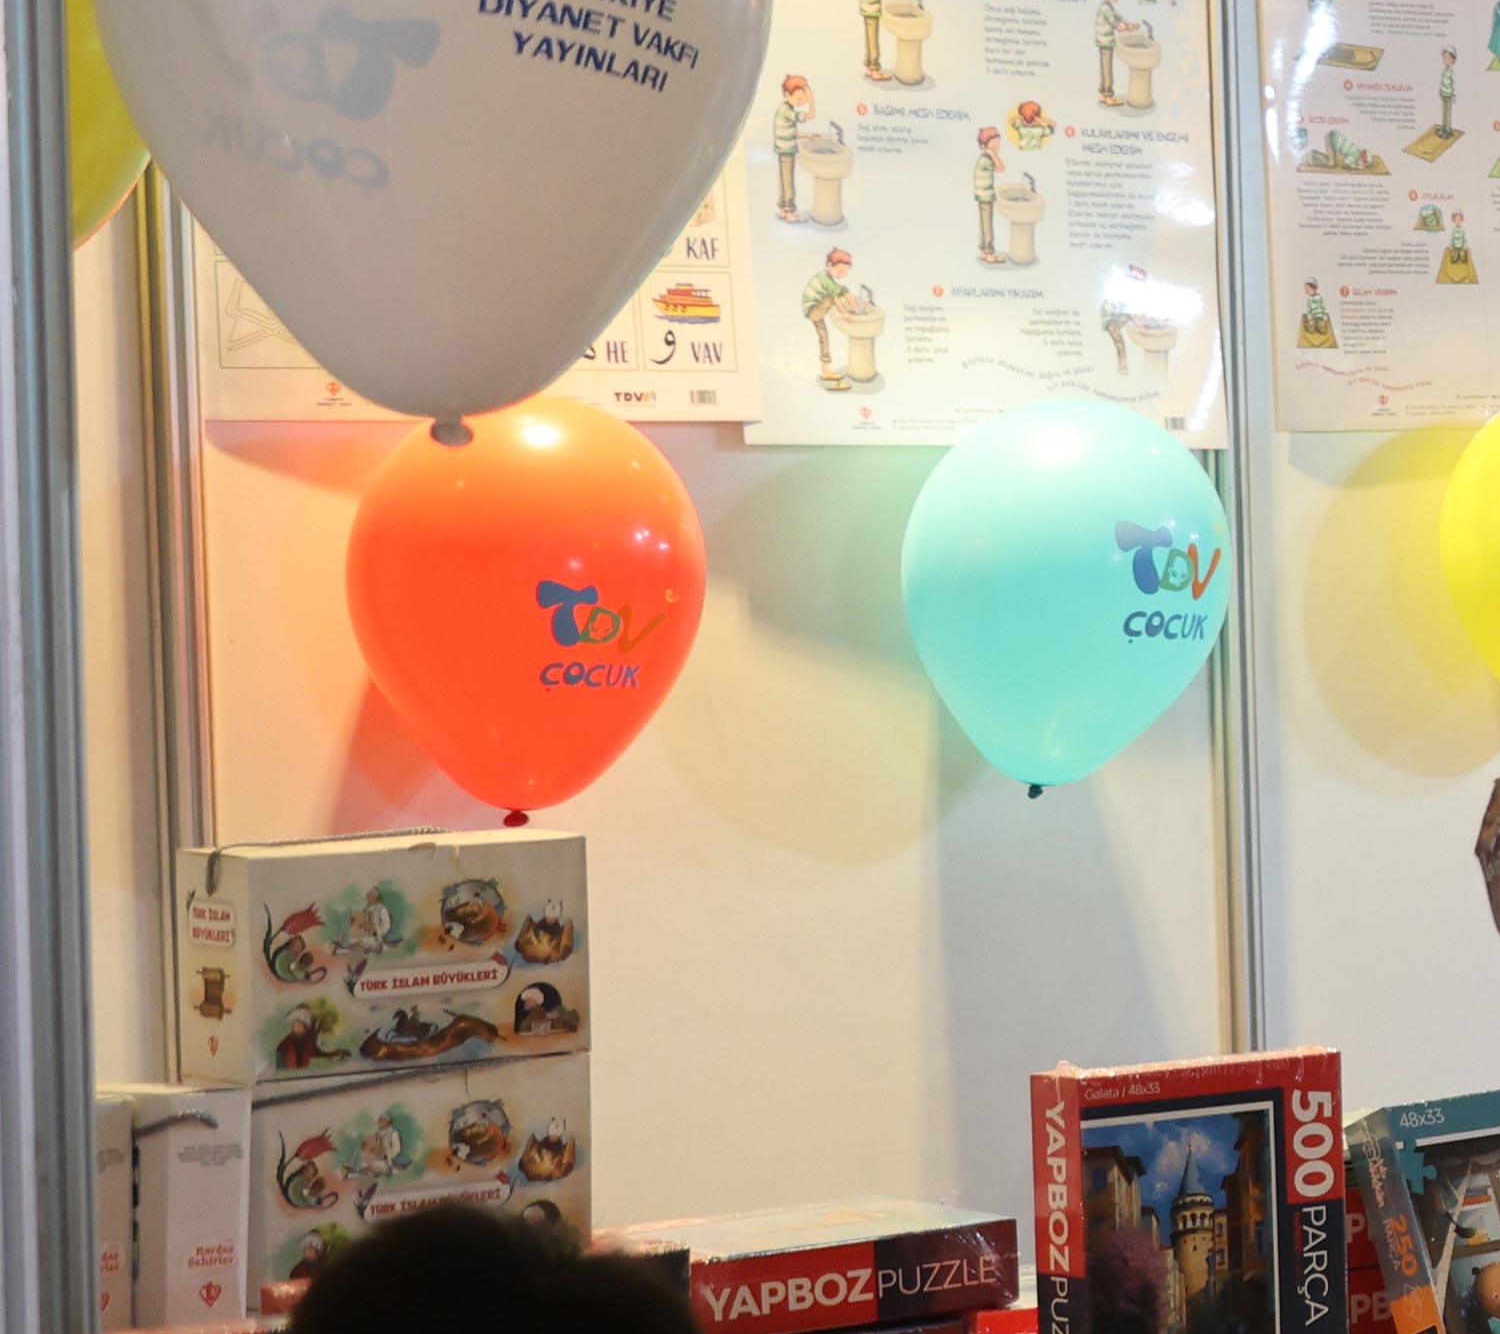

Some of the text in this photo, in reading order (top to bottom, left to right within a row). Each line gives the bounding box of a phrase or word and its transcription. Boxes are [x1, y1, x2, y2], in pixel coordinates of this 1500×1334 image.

[512, 31, 670, 93] YAYINLARI
[631, 20, 700, 70] VAKFI
[685, 236, 721, 261] KAF
[606, 340, 631, 364] HE
[690, 341, 724, 365] VAV
[1115, 519, 1222, 600] TDV
[535, 579, 667, 655] TDV
[1122, 610, 1209, 645] ÇOCUK
[539, 661, 642, 693] ÇOCUK
[359, 966, 499, 993] TÜRK İSLAM BÜYÜKLERİ
[1084, 1083, 1118, 1101] Galata
[1128, 1081, 1162, 1096] 48x33
[1399, 1107, 1446, 1129] 48x33
[1043, 1099, 1072, 1275] YAPBOZ
[1290, 1087, 1335, 1328] 500 PARÇA
[1389, 1213, 1419, 1278] 250
[702, 1255, 999, 1323] YAPBOZ PUZZLE
